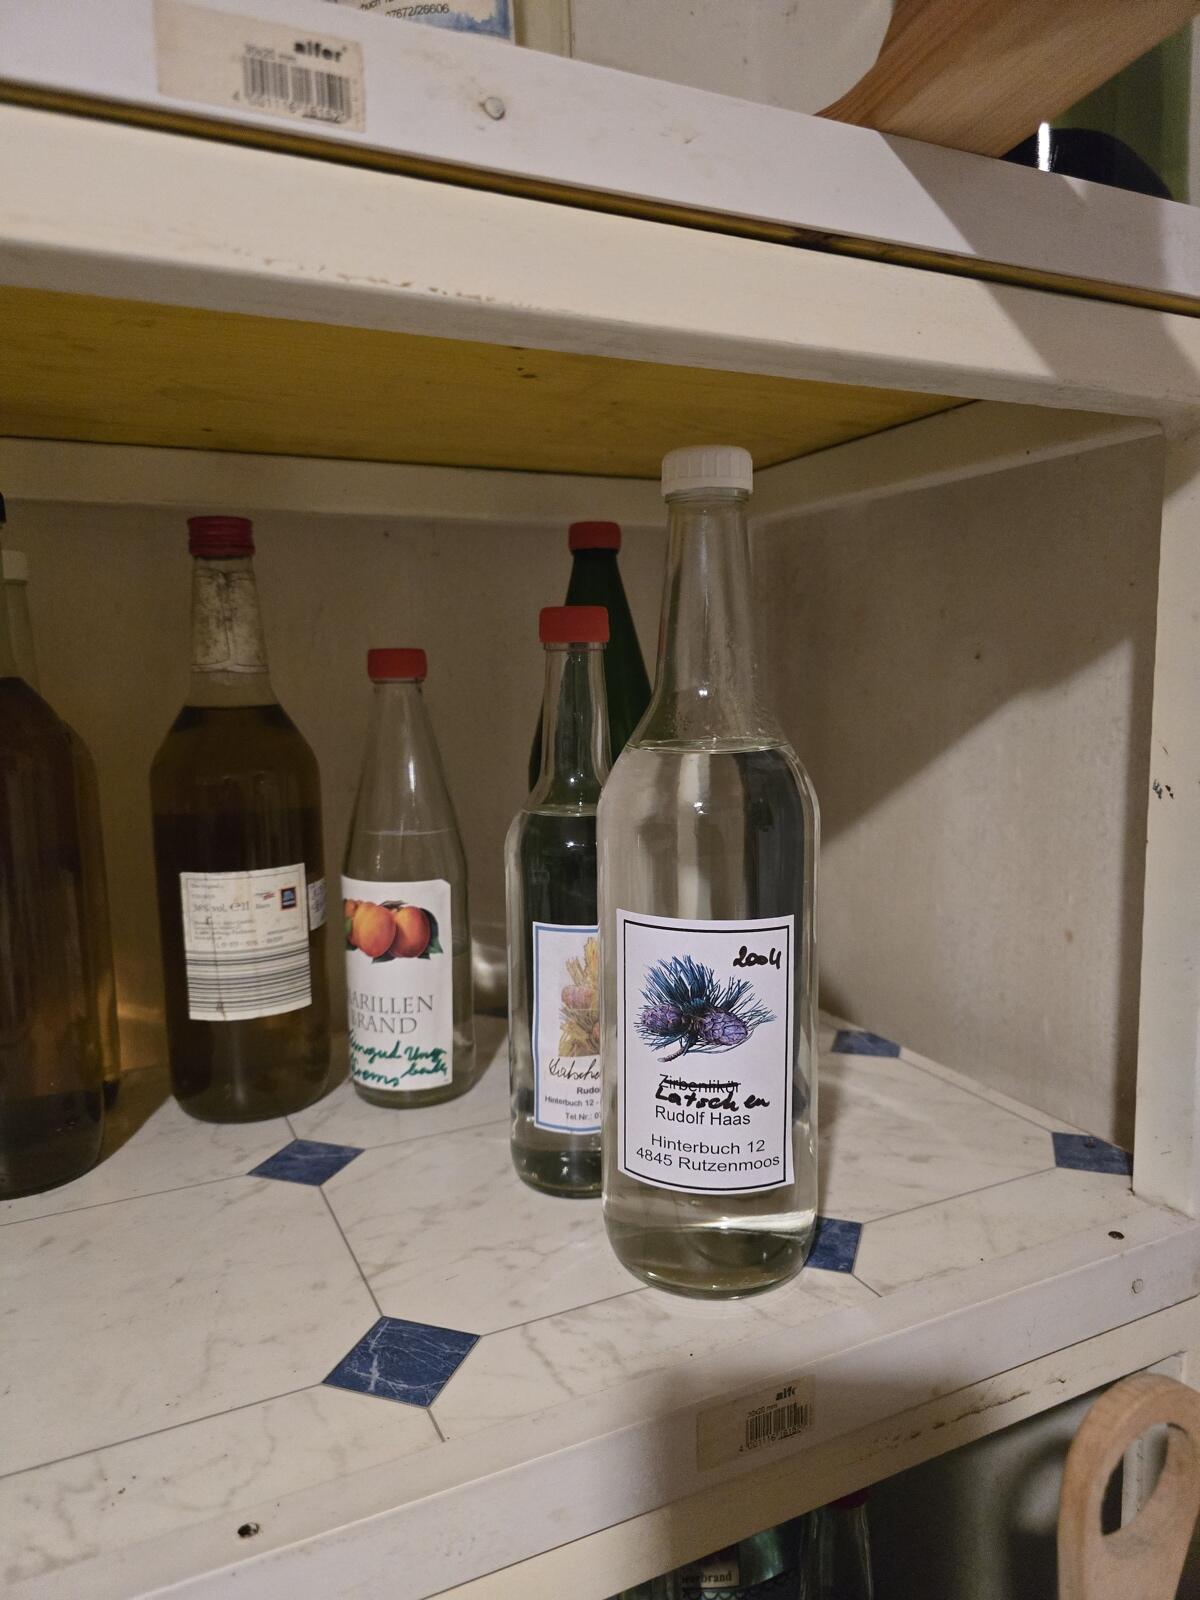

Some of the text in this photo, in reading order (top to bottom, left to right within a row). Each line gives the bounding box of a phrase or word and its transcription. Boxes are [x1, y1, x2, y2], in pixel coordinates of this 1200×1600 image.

[294, 40, 343, 62] alfer
[733, 945, 782, 970] 2004
[350, 990, 433, 1015] ARILLEN
[545, 1096, 583, 1107] Hinterbuch
[655, 1105, 751, 1126] Rudolf Haas
[651, 1133, 765, 1154] Hinterbuch 12
[636, 1146, 780, 1173] 4845 Rutzenmoos
